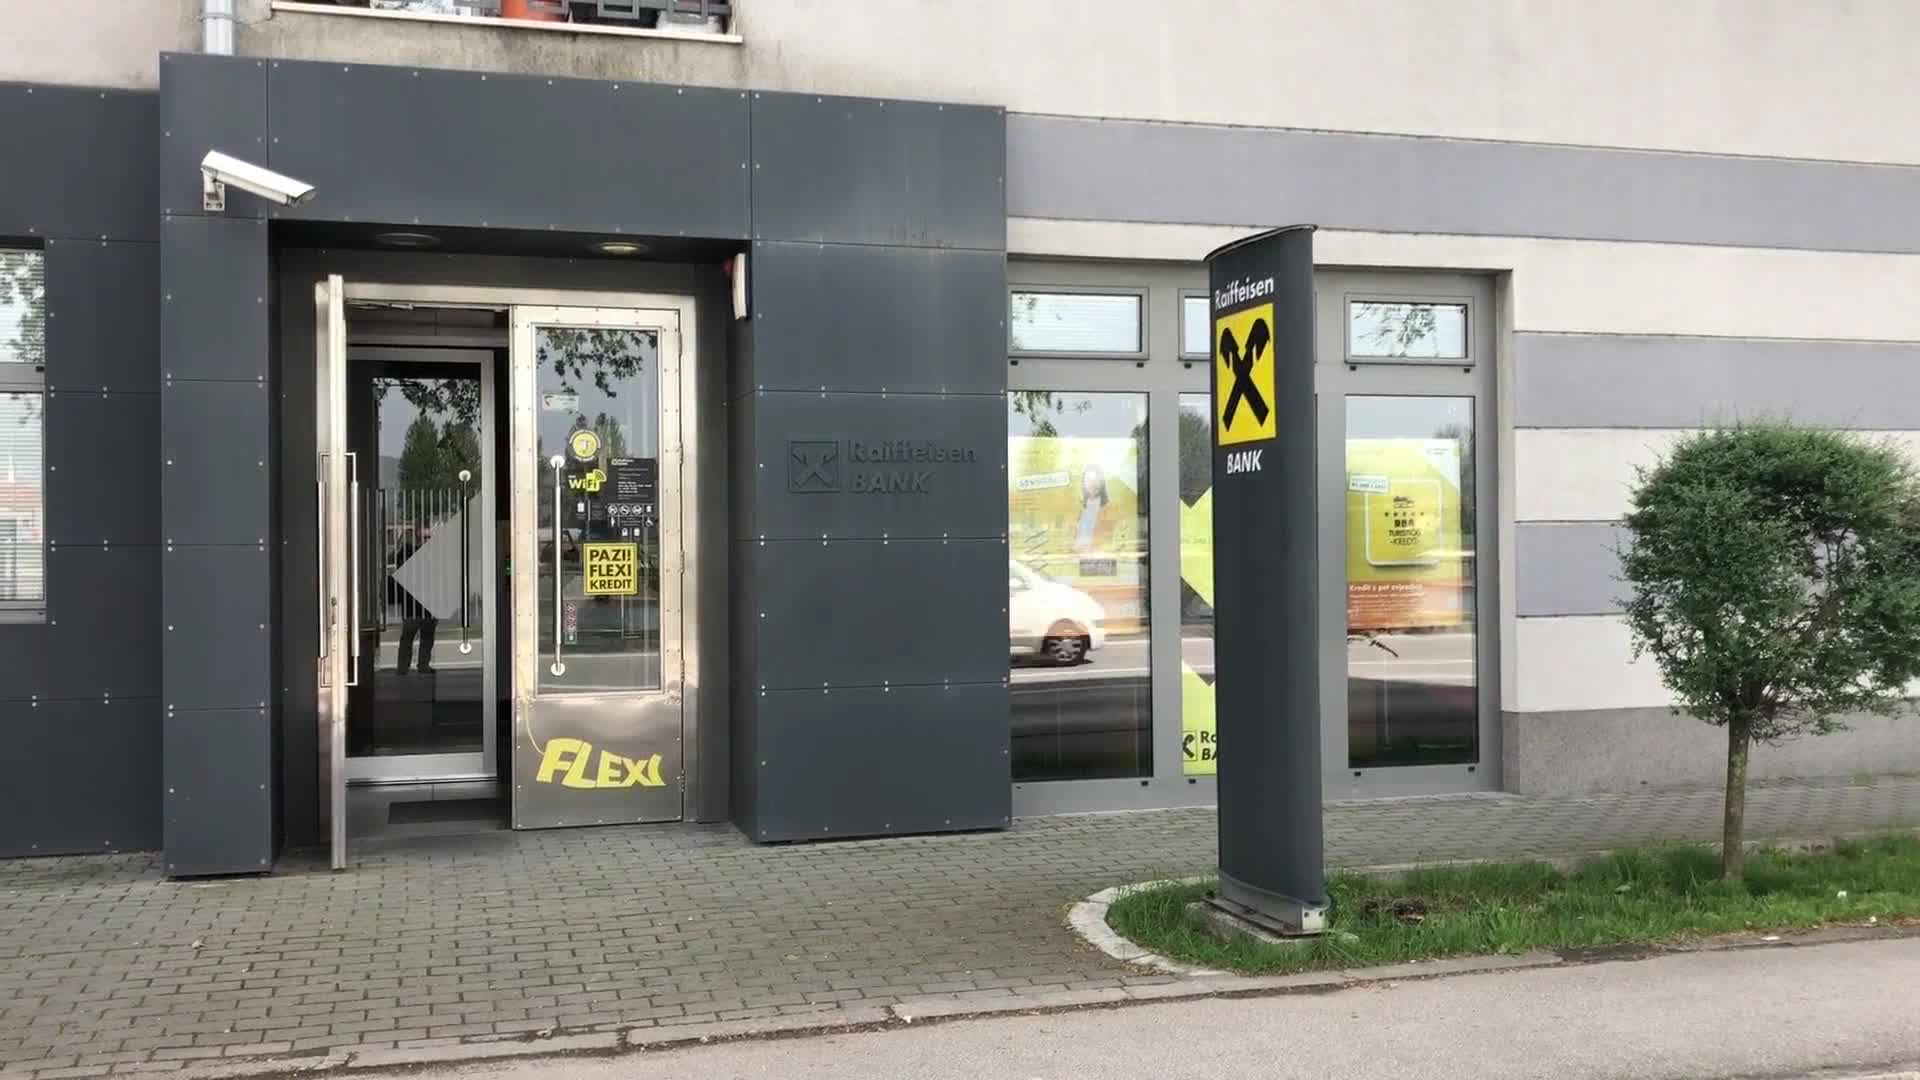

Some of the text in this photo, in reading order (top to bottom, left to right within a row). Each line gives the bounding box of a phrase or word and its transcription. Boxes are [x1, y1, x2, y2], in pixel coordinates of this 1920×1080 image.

[1215, 276, 1275, 310] Raiffeisen
[849, 440, 977, 463] Raiffeisen
[1227, 449, 1263, 475] BANK
[849, 472, 935, 495] BANK
[589, 549, 631, 561] PAZI!
[589, 564, 632, 577] FLEXI
[590, 579, 633, 590] KREDIT
[536, 738, 667, 788] FLEXI
